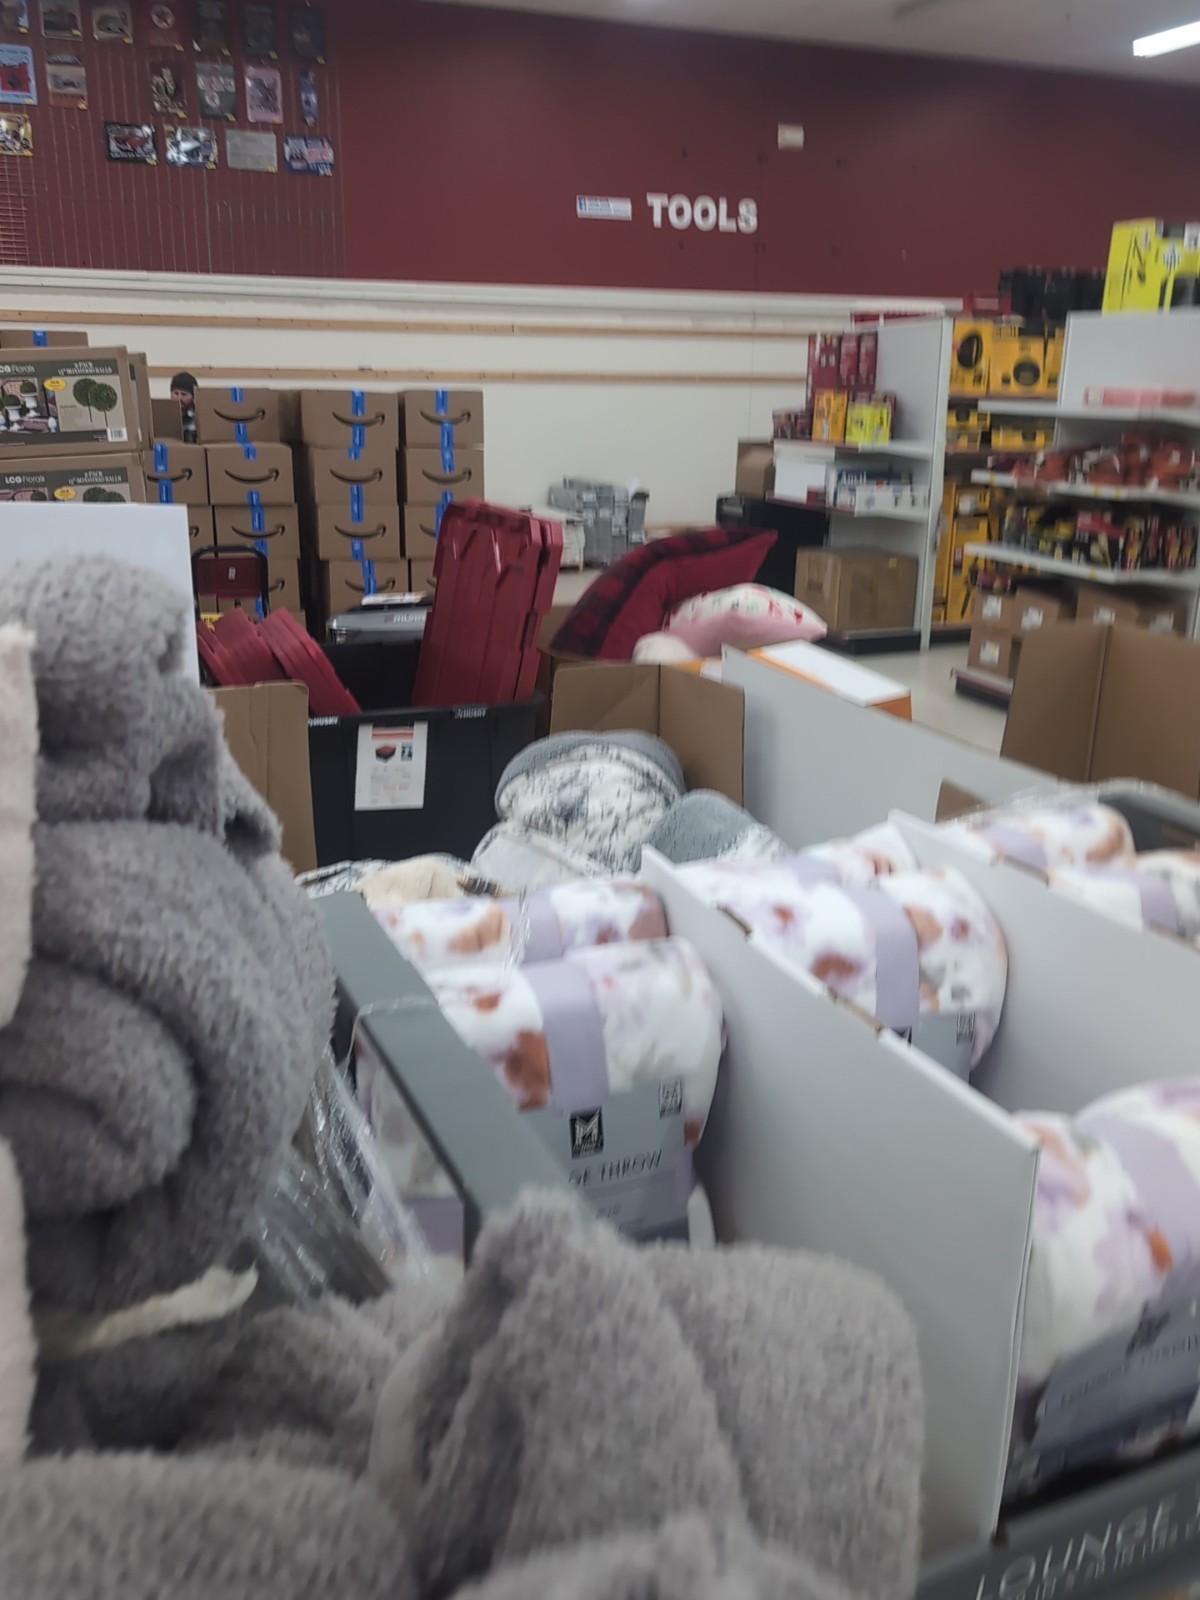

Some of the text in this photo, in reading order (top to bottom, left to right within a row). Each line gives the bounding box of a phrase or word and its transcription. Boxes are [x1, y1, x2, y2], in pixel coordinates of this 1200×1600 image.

[646, 192, 758, 234] TOOLS
[0, 364, 11, 373] CG
[5, 476, 22, 484] LCG
[313, 715, 339, 727] HUSKY
[600, 1148, 662, 1182] THROW
